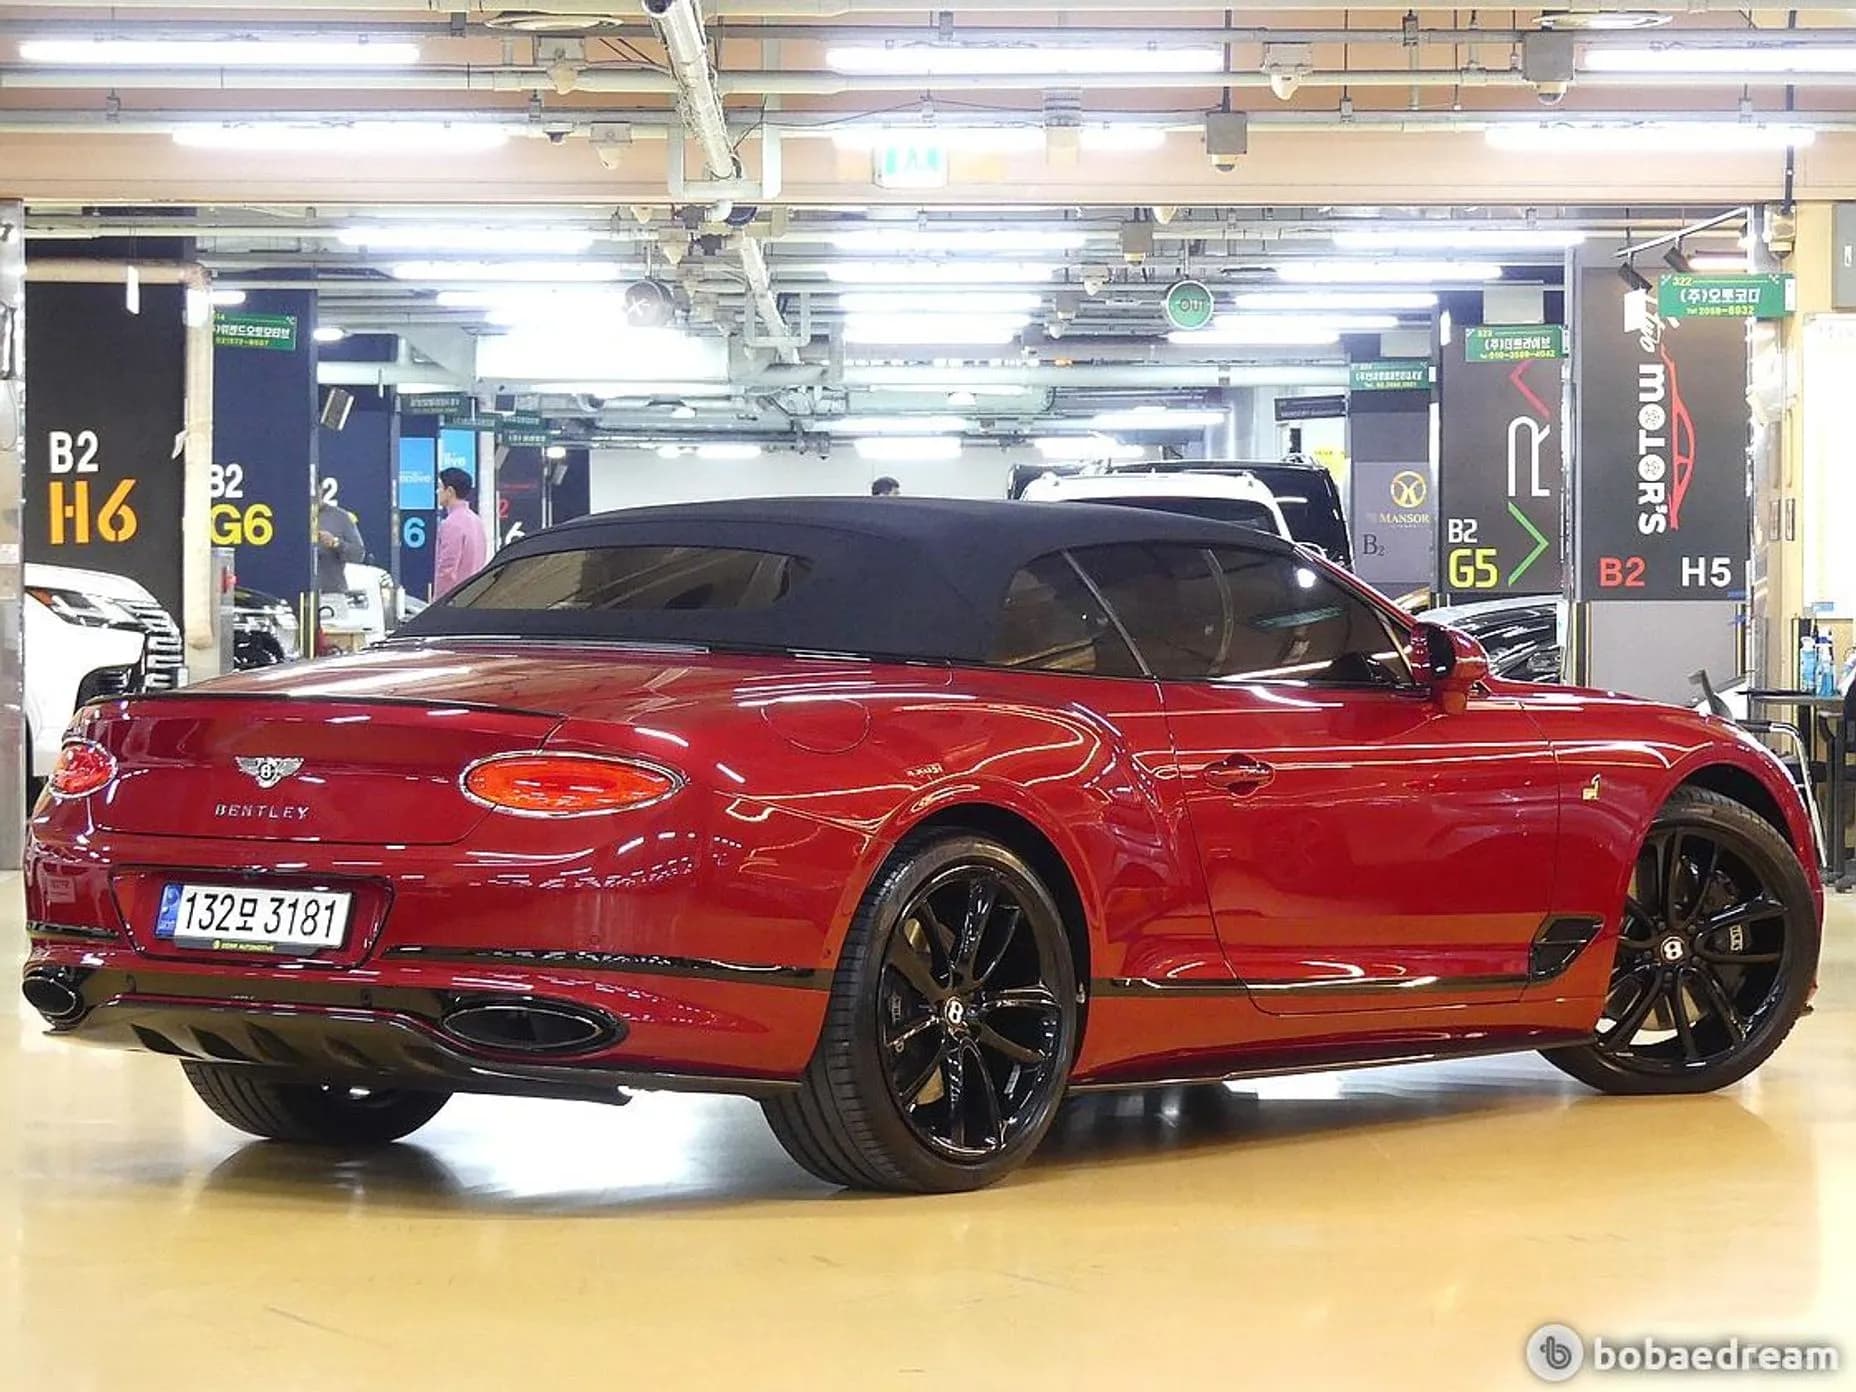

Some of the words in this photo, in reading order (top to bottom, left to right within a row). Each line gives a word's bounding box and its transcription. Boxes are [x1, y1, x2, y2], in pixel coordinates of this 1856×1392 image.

[1180, 299, 1207, 313] OUT
[49, 430, 99, 474] B2
[210, 463, 244, 499] B2
[49, 479, 138, 545] H6
[210, 503, 273, 545] G6
[1363, 533, 1385, 556] B2
[1449, 519, 1478, 544] B2
[1448, 548, 1498, 589] G5
[1600, 557, 1646, 587] B2
[1681, 557, 1732, 587] H5
[215, 803, 310, 820] BENTLEY
[185, 892, 259, 932] 132모
[263, 897, 337, 938] 3181
